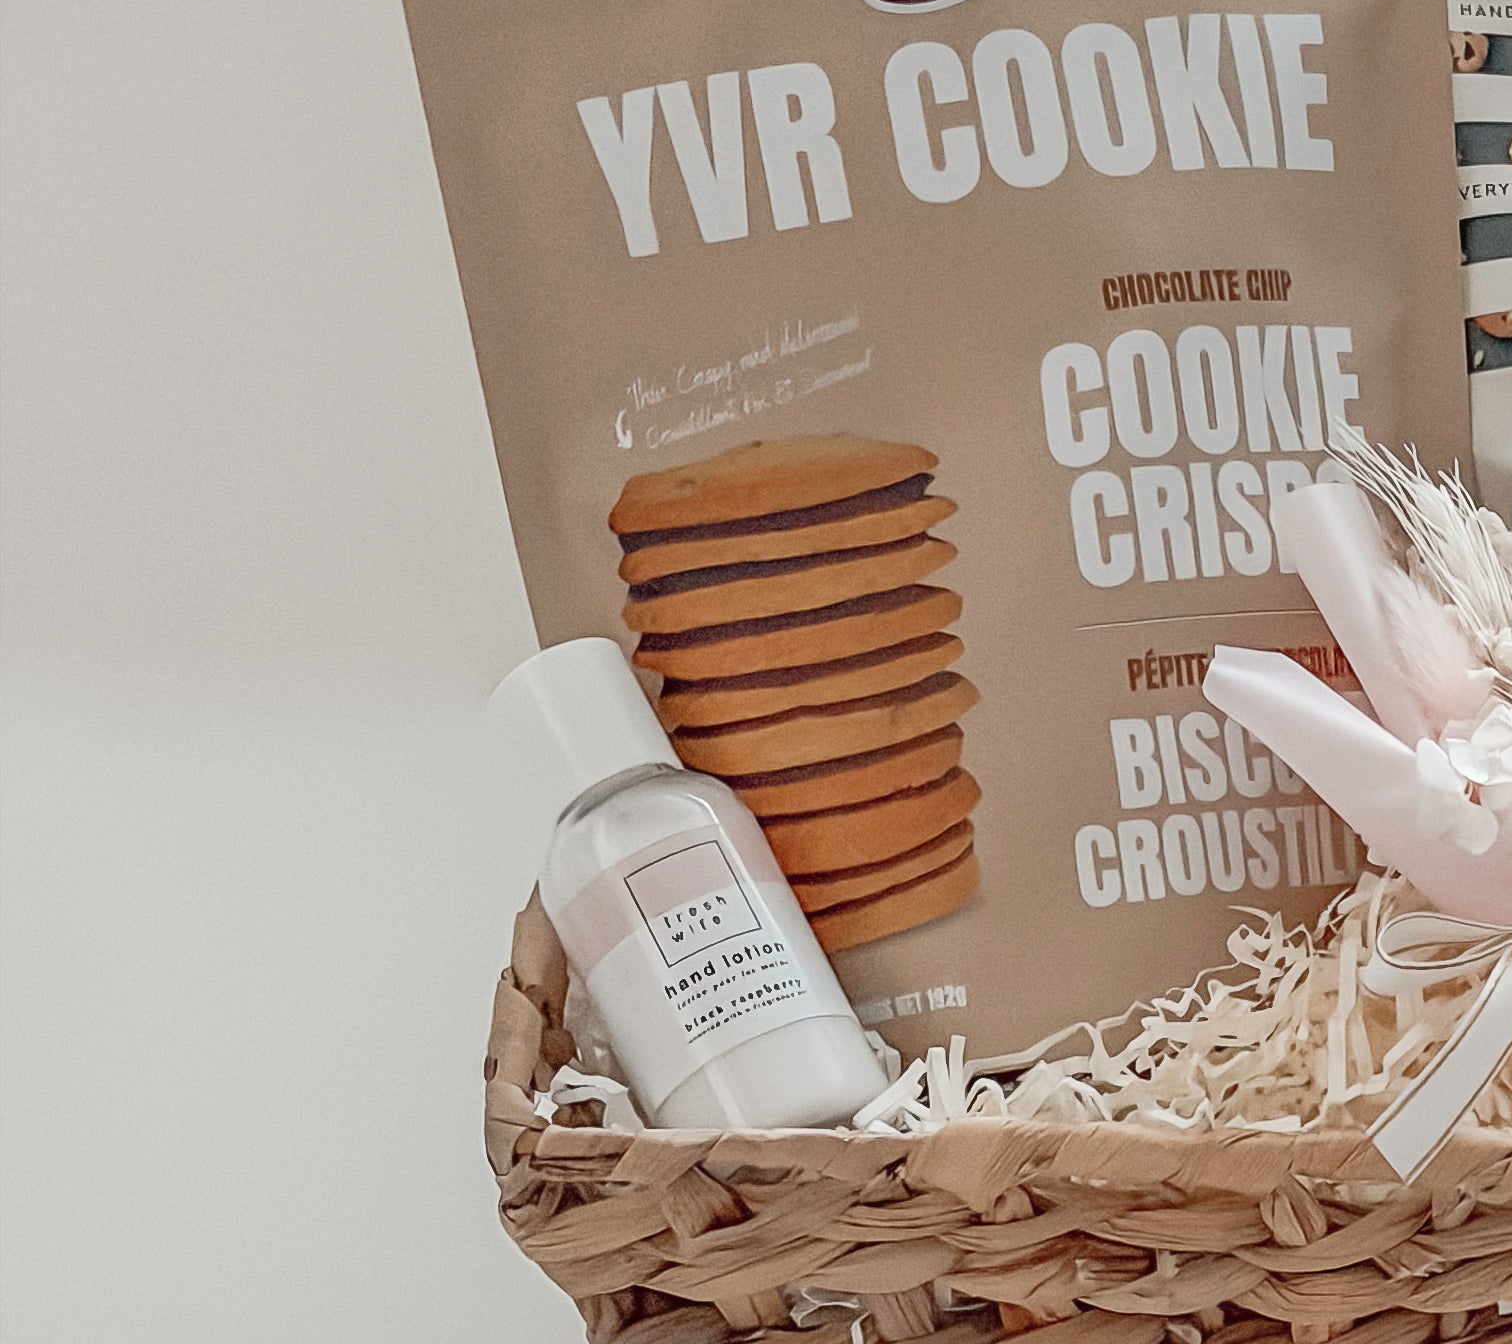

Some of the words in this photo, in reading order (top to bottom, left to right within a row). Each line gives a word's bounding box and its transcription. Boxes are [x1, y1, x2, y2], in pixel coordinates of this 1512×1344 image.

[576, 61, 853, 258] YVR
[883, 13, 1335, 204] COOKIE
[1102, 268, 1241, 311] CHOCOLATE
[1246, 269, 1292, 301] CHIP
[1040, 324, 1367, 468] COOKIE
[1070, 459, 1352, 588] CRISP
[1074, 805, 1358, 908] CROUSTILL
[664, 960, 716, 1000] hand
[722, 941, 785, 969] lotion
[684, 1005, 724, 1033] black
